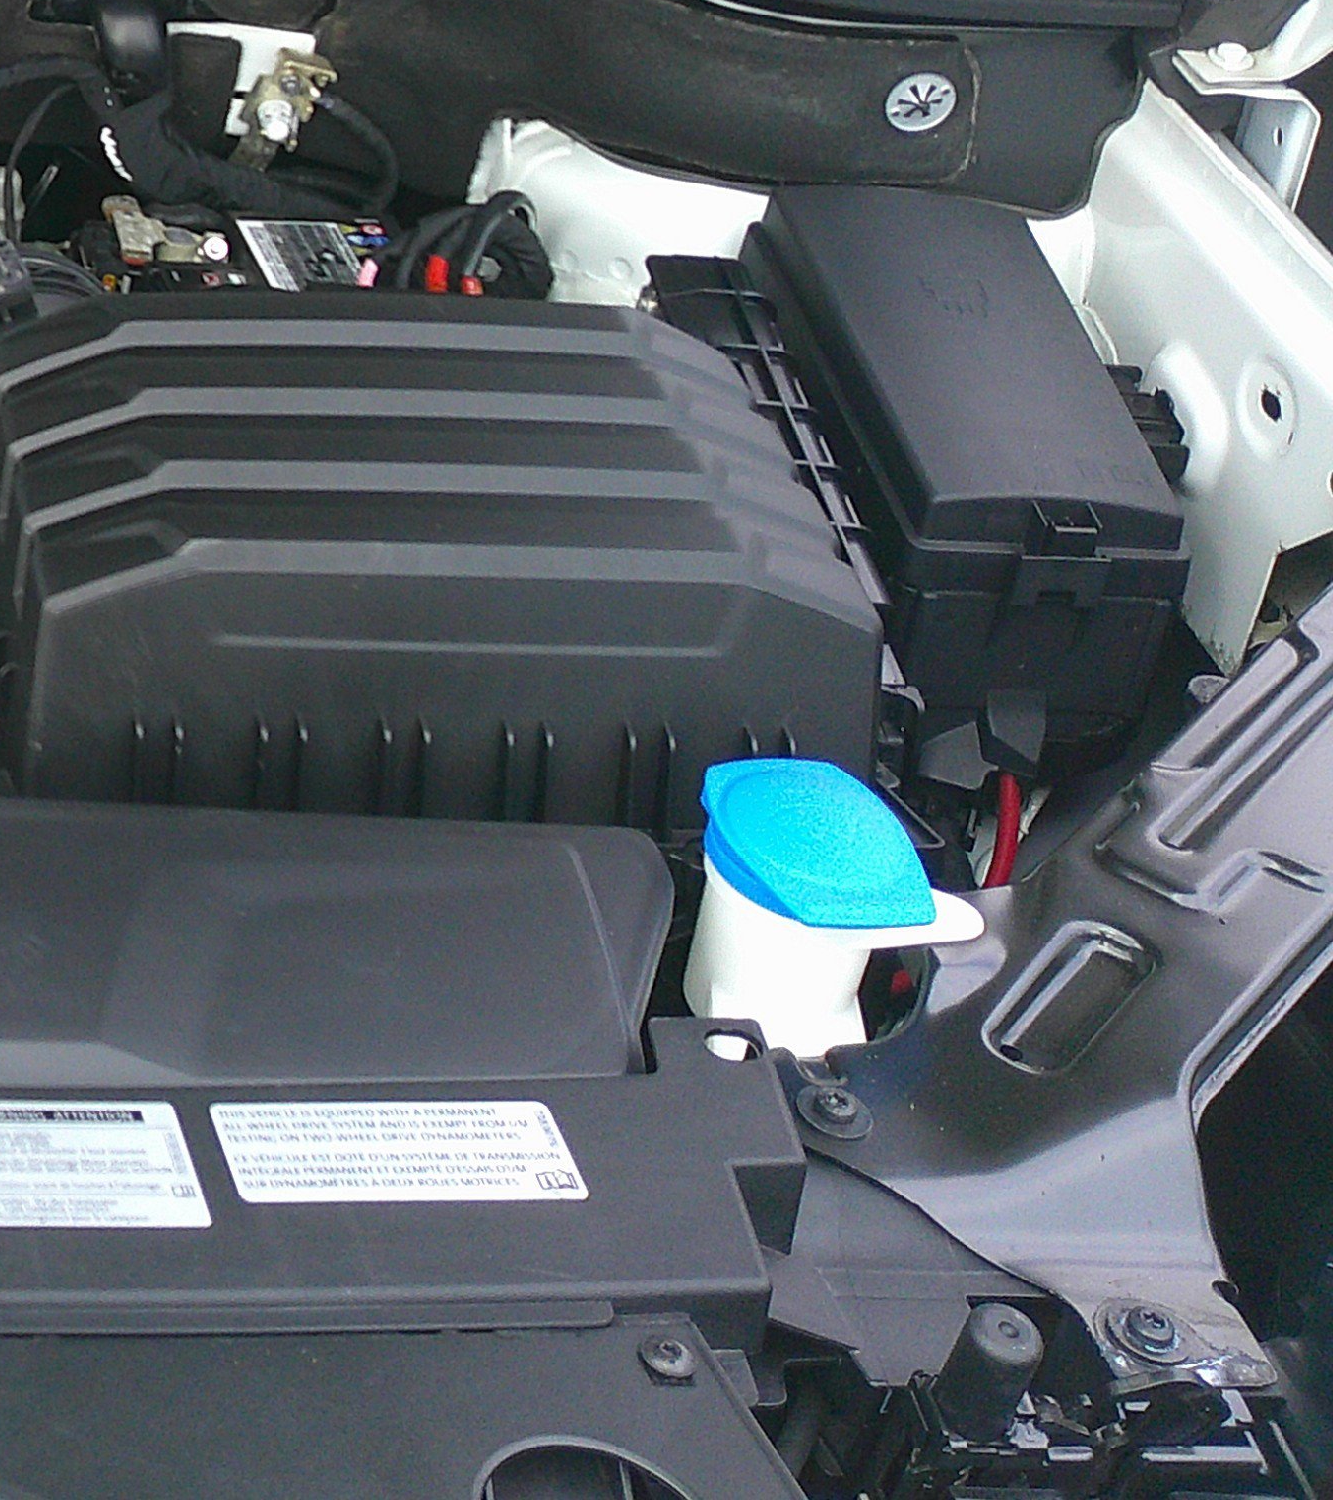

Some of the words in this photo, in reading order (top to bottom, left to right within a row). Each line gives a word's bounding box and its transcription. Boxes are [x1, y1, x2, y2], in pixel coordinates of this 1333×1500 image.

[423, 1108, 496, 1117] PERMANENT
[292, 1121, 328, 1129] DRIVE
[331, 1120, 376, 1129] SYSTEM
[379, 1120, 406, 1128] AND
[409, 1120, 420, 1128] IS
[423, 1120, 467, 1128] EXEMPT
[471, 1120, 505, 1128] FROM
[227, 1134, 277, 1143] TESTING
[280, 1134, 299, 1142] ON
[381, 1133, 417, 1141] DRIVE
[421, 1132, 522, 1141] DYNAMOMETERS
[473, 1152, 561, 1161] TRANSMISSION
[460, 1178, 520, 1186] MOTRICES
